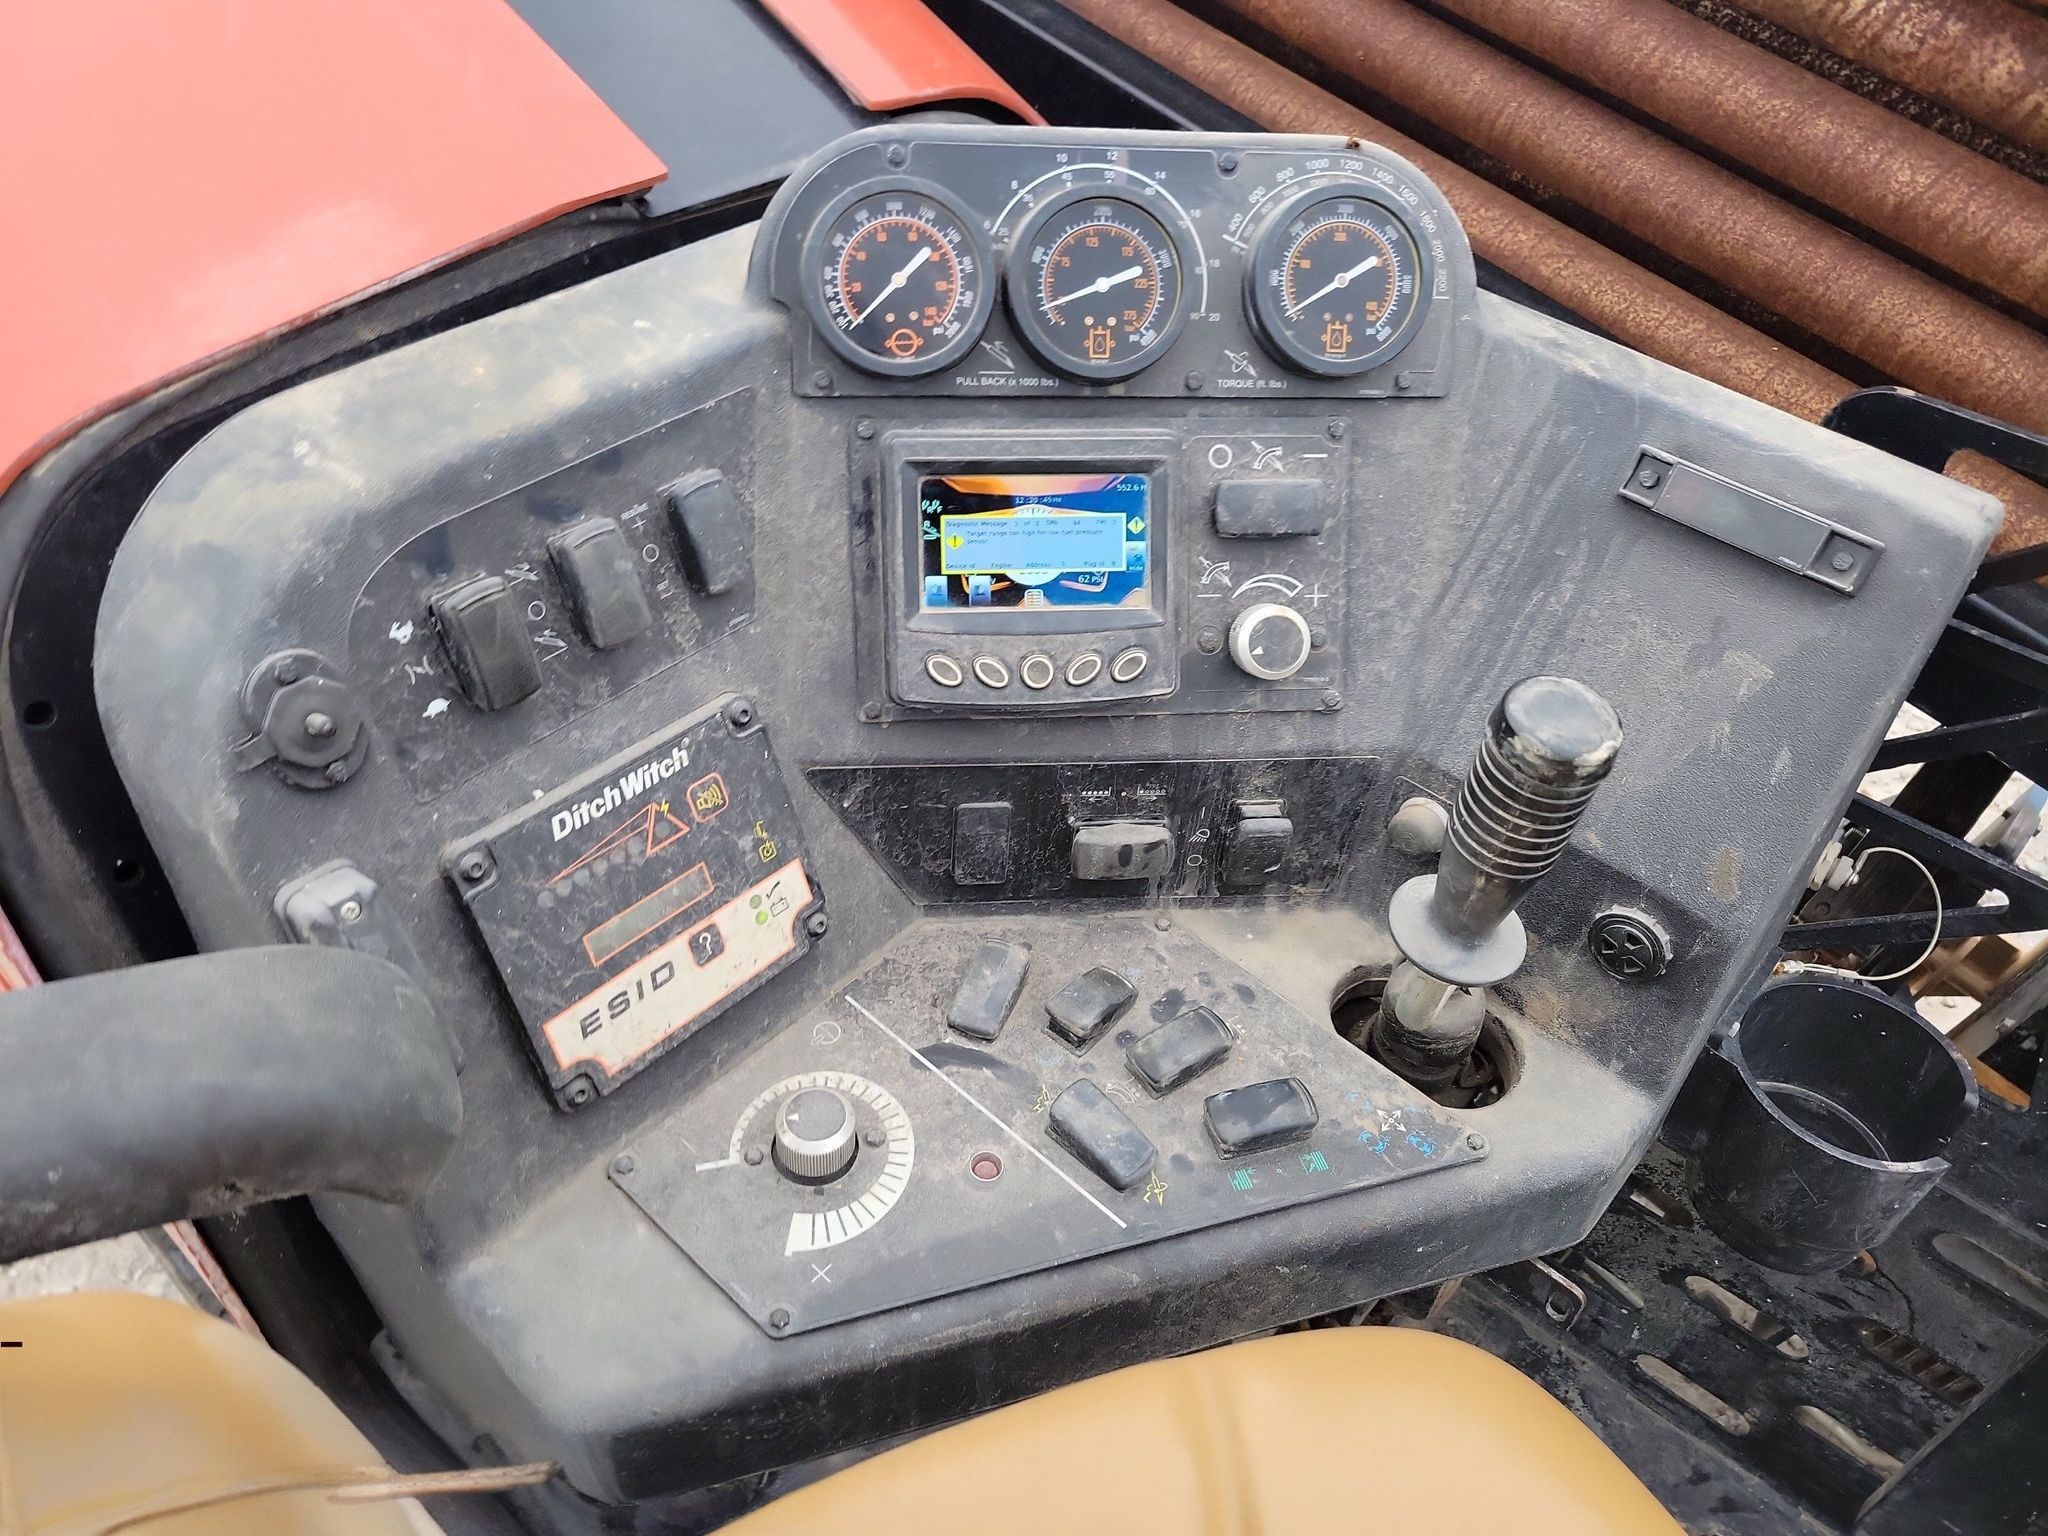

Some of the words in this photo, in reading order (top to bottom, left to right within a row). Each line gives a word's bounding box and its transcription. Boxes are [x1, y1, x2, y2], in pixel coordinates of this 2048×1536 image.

[1056, 152, 1069, 163] 10
[1106, 151, 1118, 160] 12
[1306, 158, 1329, 170] 1000
[1340, 160, 1363, 171] 1200
[1154, 171, 1166, 180] 14
[1276, 167, 1295, 182] 800
[1372, 168, 1394, 185] 1400
[1010, 180, 1019, 190] 8
[1248, 186, 1266, 204] 600
[1398, 185, 1418, 206] 1600
[1228, 213, 1244, 233] 400
[1419, 210, 1437, 233] 1800
[1438, 268, 1448, 292] 2200
[1208, 312, 1220, 321] 20
[956, 376, 979, 386] PULL
[980, 376, 1007, 386] BACK
[1018, 377, 1039, 386] 1000
[1216, 379, 1255, 388] TORQUE
[1078, 574, 1090, 583] 62
[1091, 575, 1104, 583] PSI
[579, 960, 675, 1040] ESID
